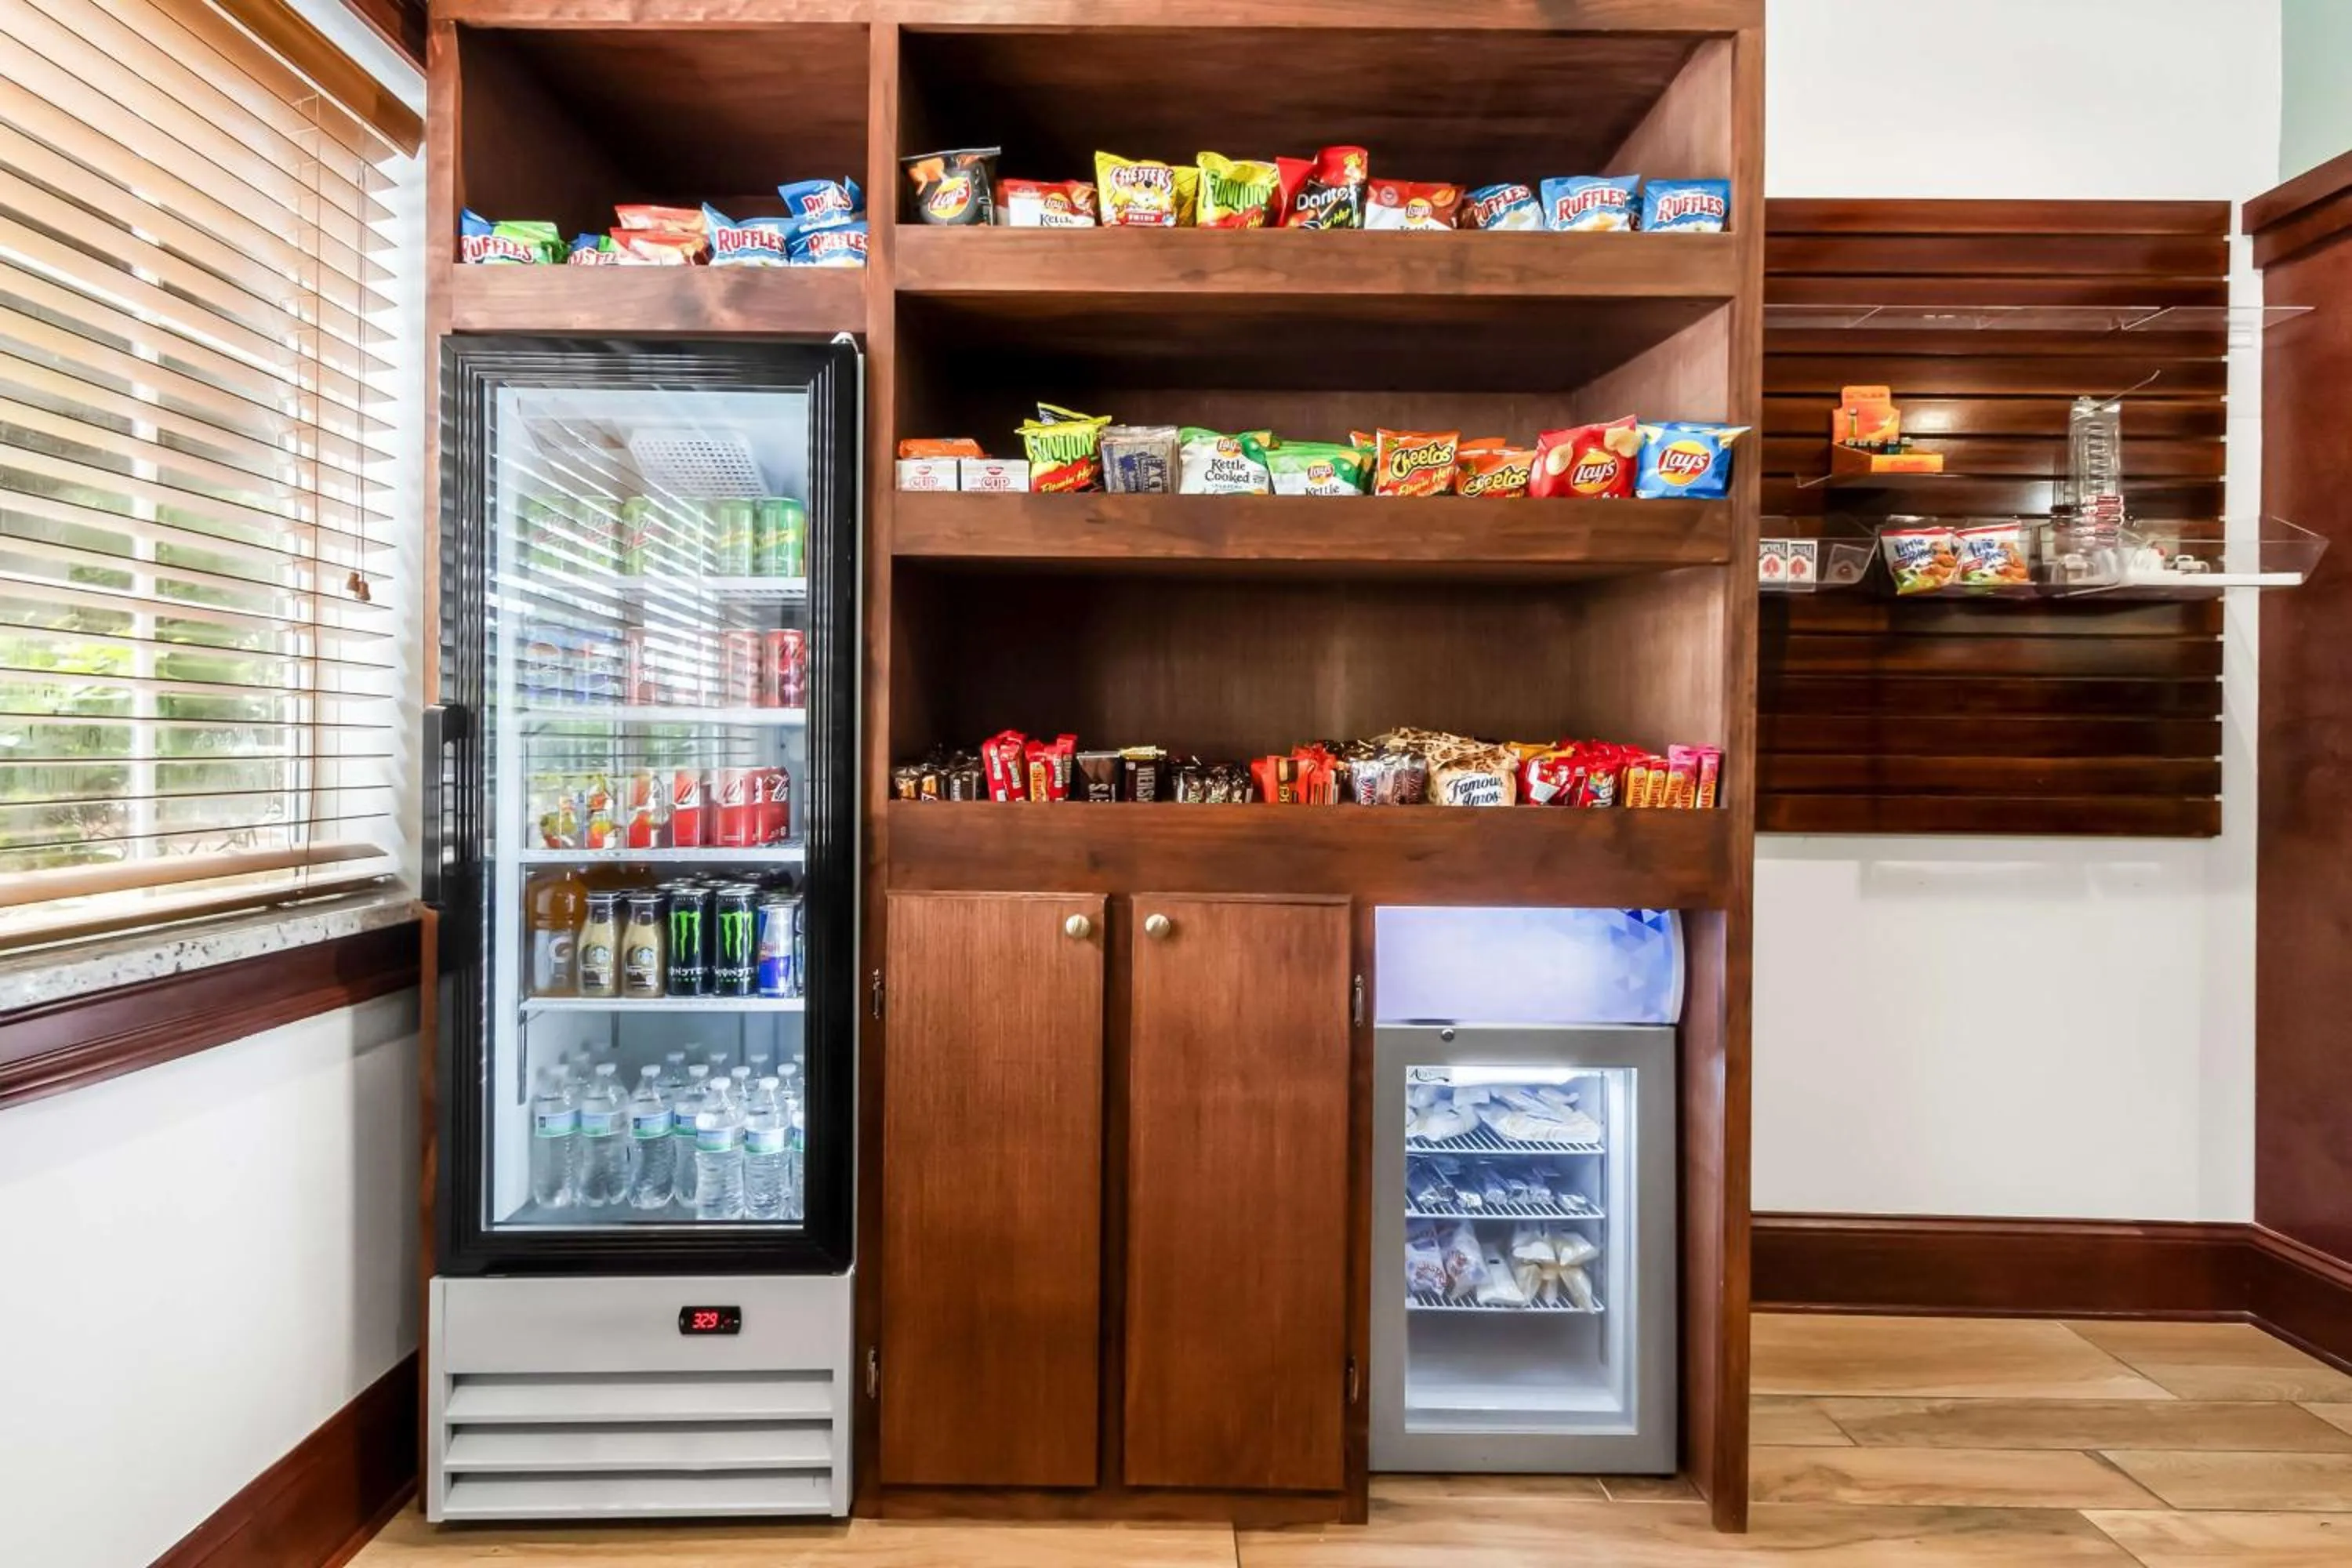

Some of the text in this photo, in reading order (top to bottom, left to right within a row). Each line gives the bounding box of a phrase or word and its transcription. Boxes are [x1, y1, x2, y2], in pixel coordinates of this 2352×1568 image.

[1557, 187, 1626, 221] RUFFLES
[1657, 195, 1723, 221] RUFFLES
[717, 227, 785, 252] RUFFLES
[1211, 459, 1246, 472] Kettle
[1392, 444, 1452, 477] Cheetos
[1660, 449, 1708, 475] Lay's
[1205, 470, 1250, 483] Cooked
